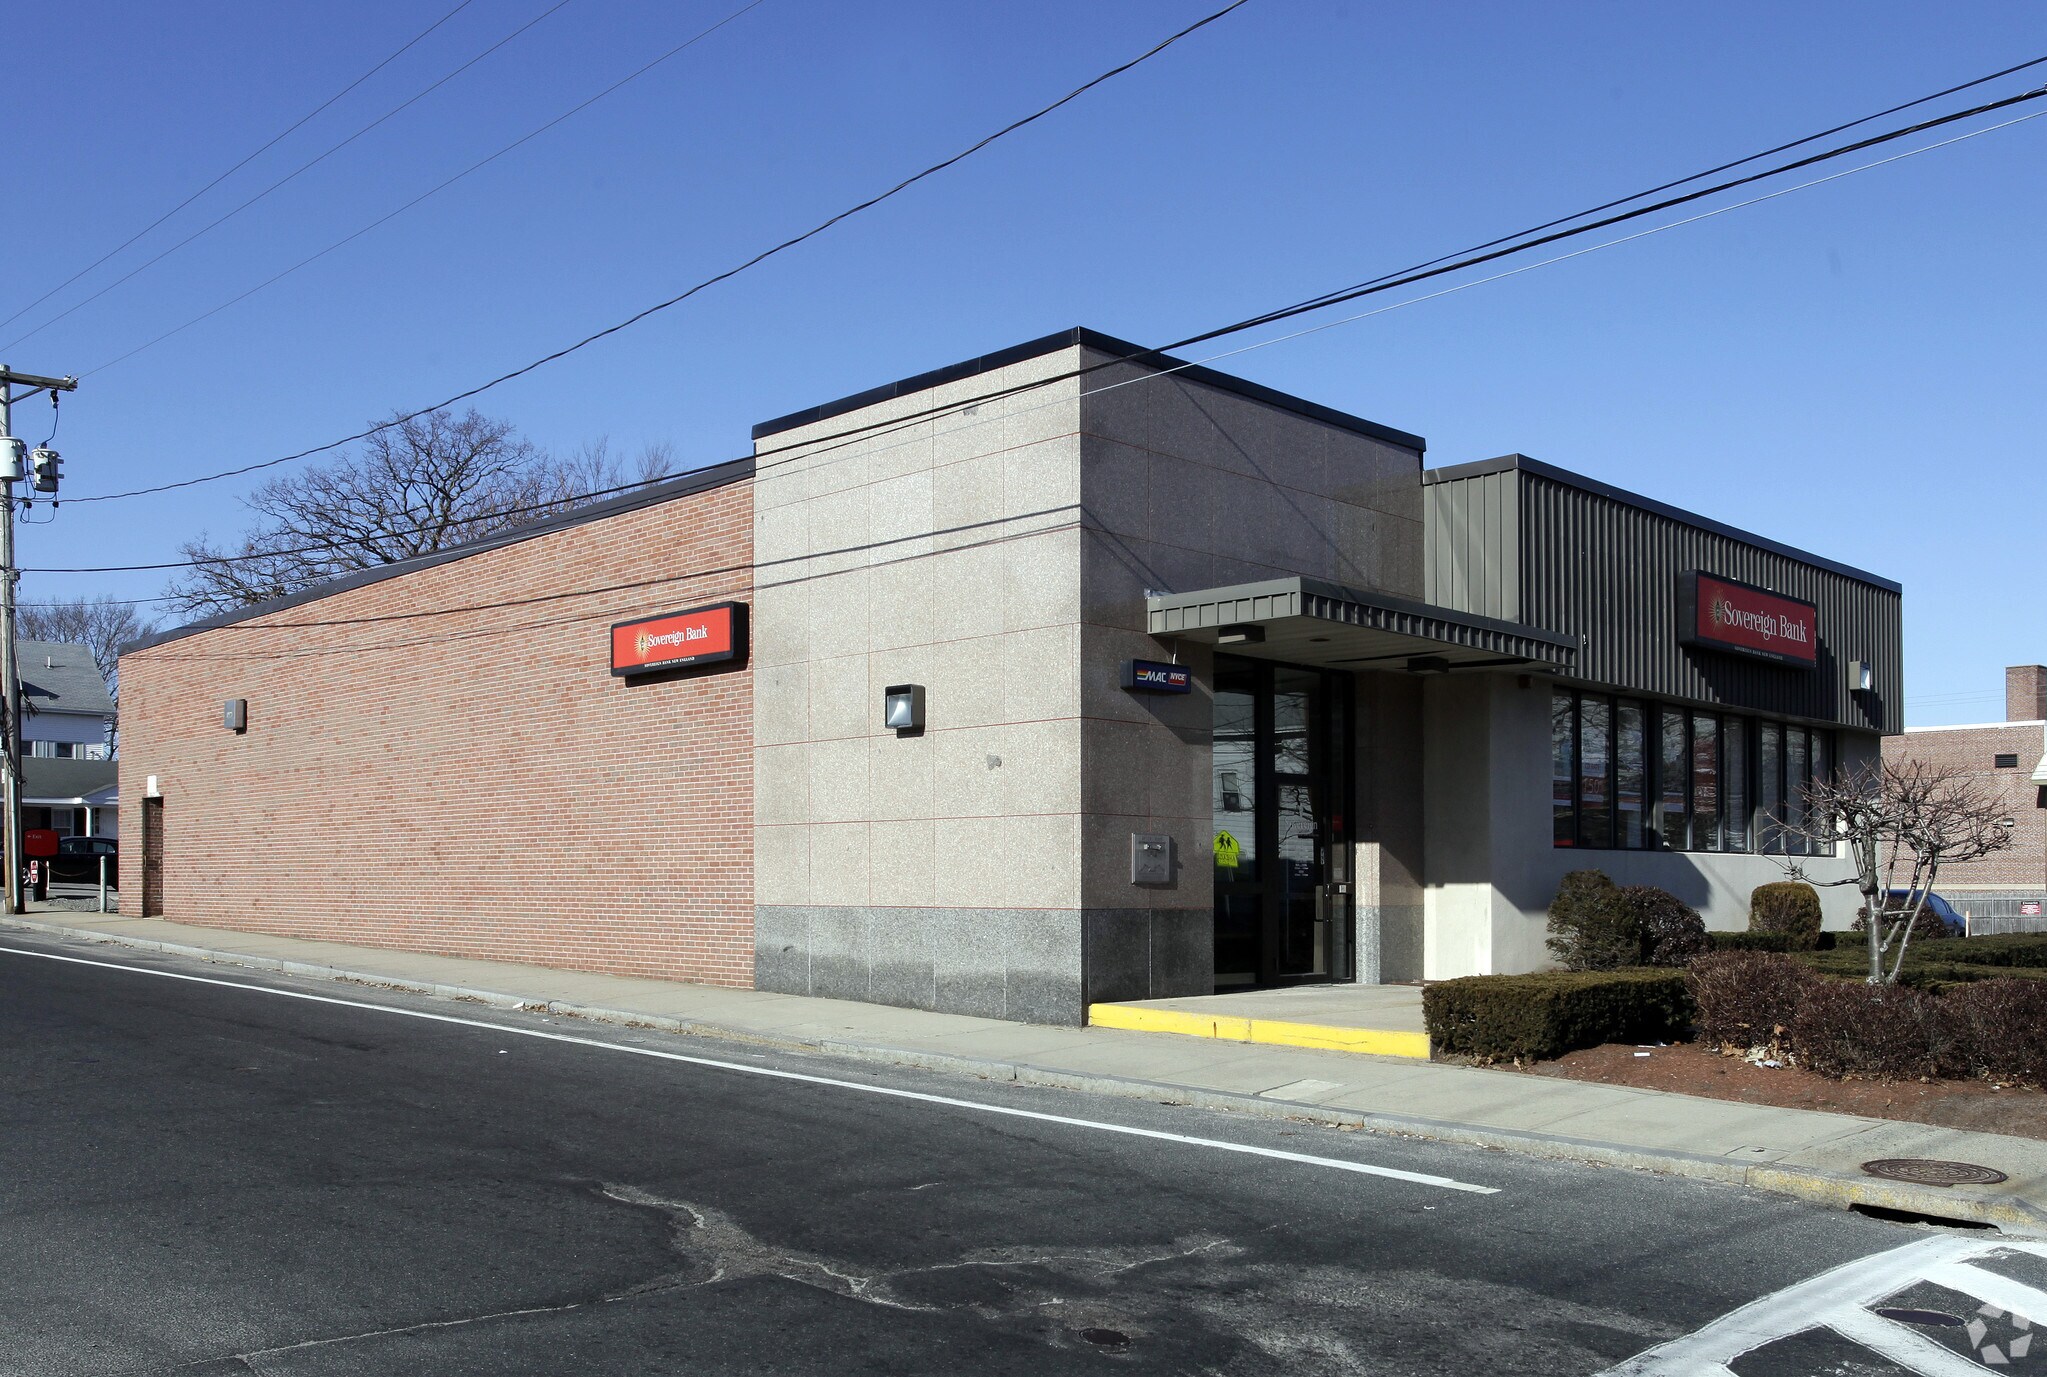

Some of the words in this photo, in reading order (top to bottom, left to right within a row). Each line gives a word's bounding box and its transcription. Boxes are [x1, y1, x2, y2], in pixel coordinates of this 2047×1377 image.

[1724, 600, 1777, 640] Sovereign
[1780, 614, 1807, 643] Bank
[648, 629, 684, 647] Sovereign
[686, 624, 708, 640] Bank
[1145, 670, 1167, 683] MAC
[1170, 672, 1186, 681] NYCE
